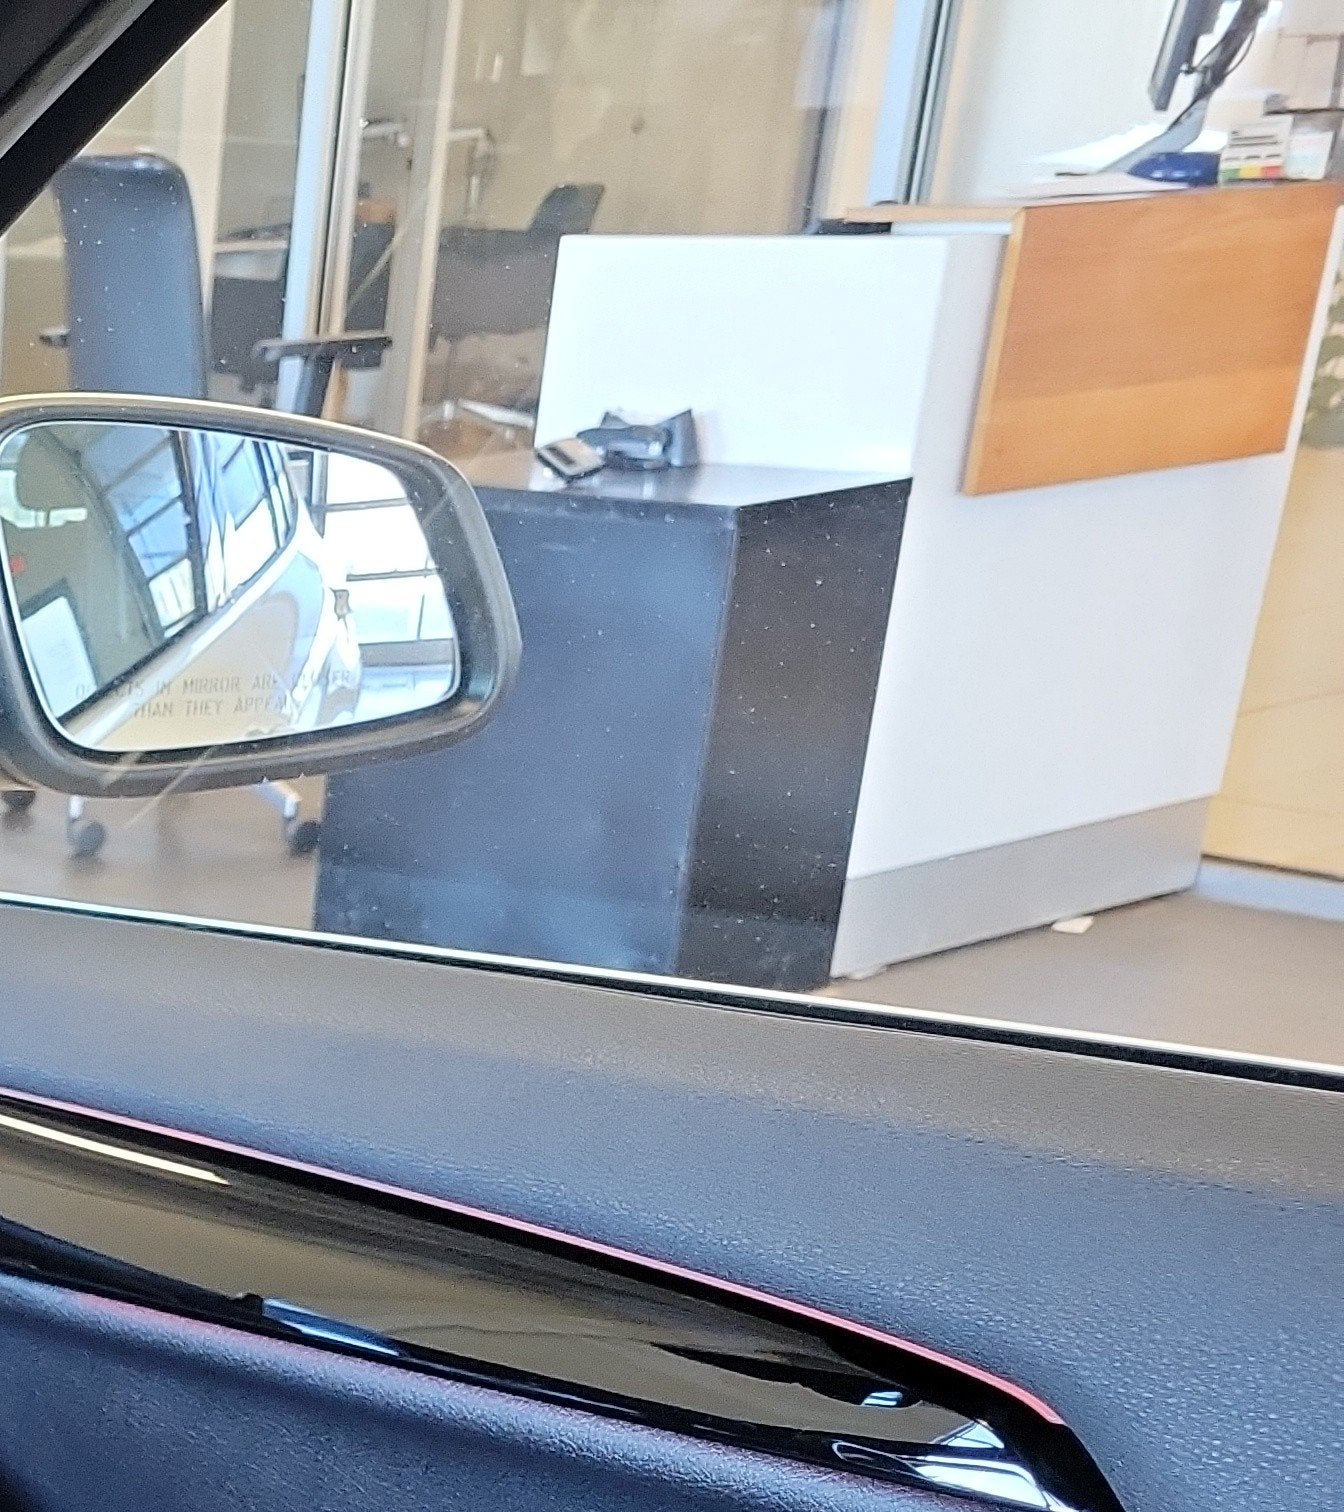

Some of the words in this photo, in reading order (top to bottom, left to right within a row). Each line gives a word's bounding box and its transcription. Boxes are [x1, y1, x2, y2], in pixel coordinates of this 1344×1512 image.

[183, 676, 241, 695] MIRROR
[186, 697, 224, 717] THEY
[234, 693, 290, 712] APPEA
